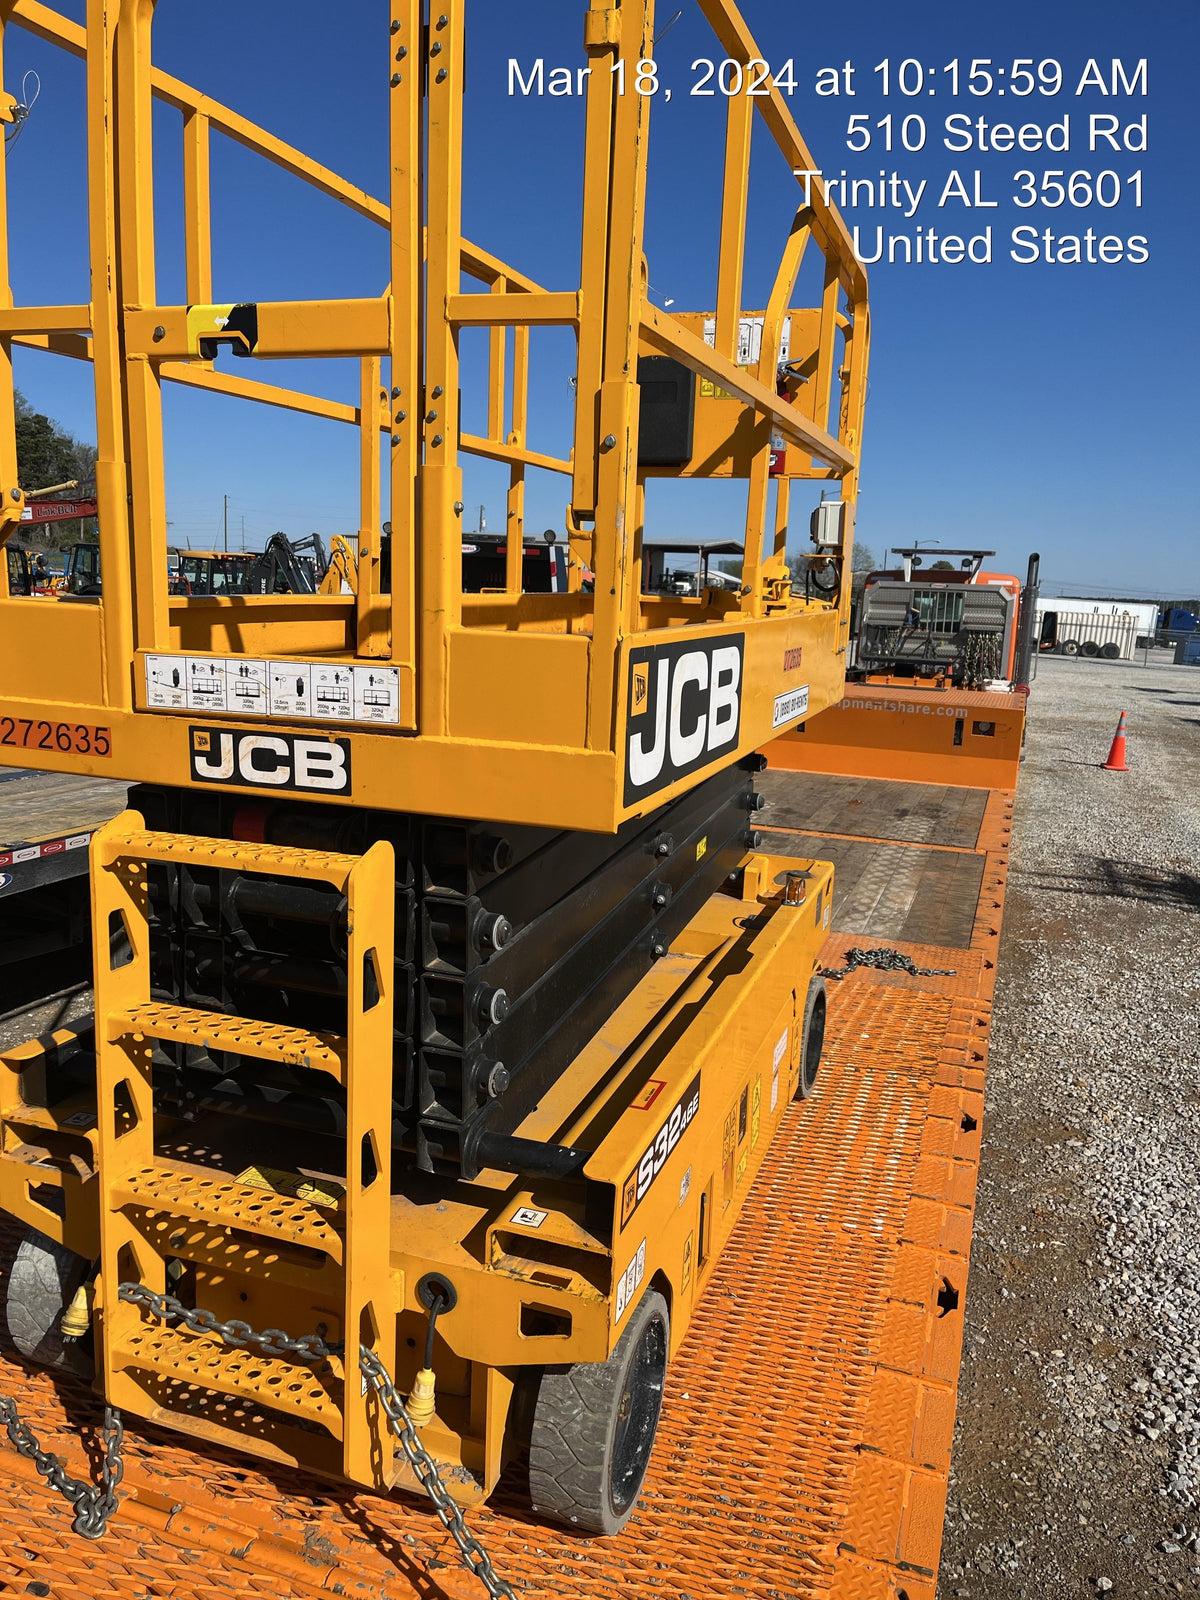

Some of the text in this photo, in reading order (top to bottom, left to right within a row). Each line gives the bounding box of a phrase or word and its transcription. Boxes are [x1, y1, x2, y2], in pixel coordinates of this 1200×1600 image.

[0, 717, 110, 755] 272635
[629, 646, 741, 787] JCB
[195, 733, 347, 790] JCB
